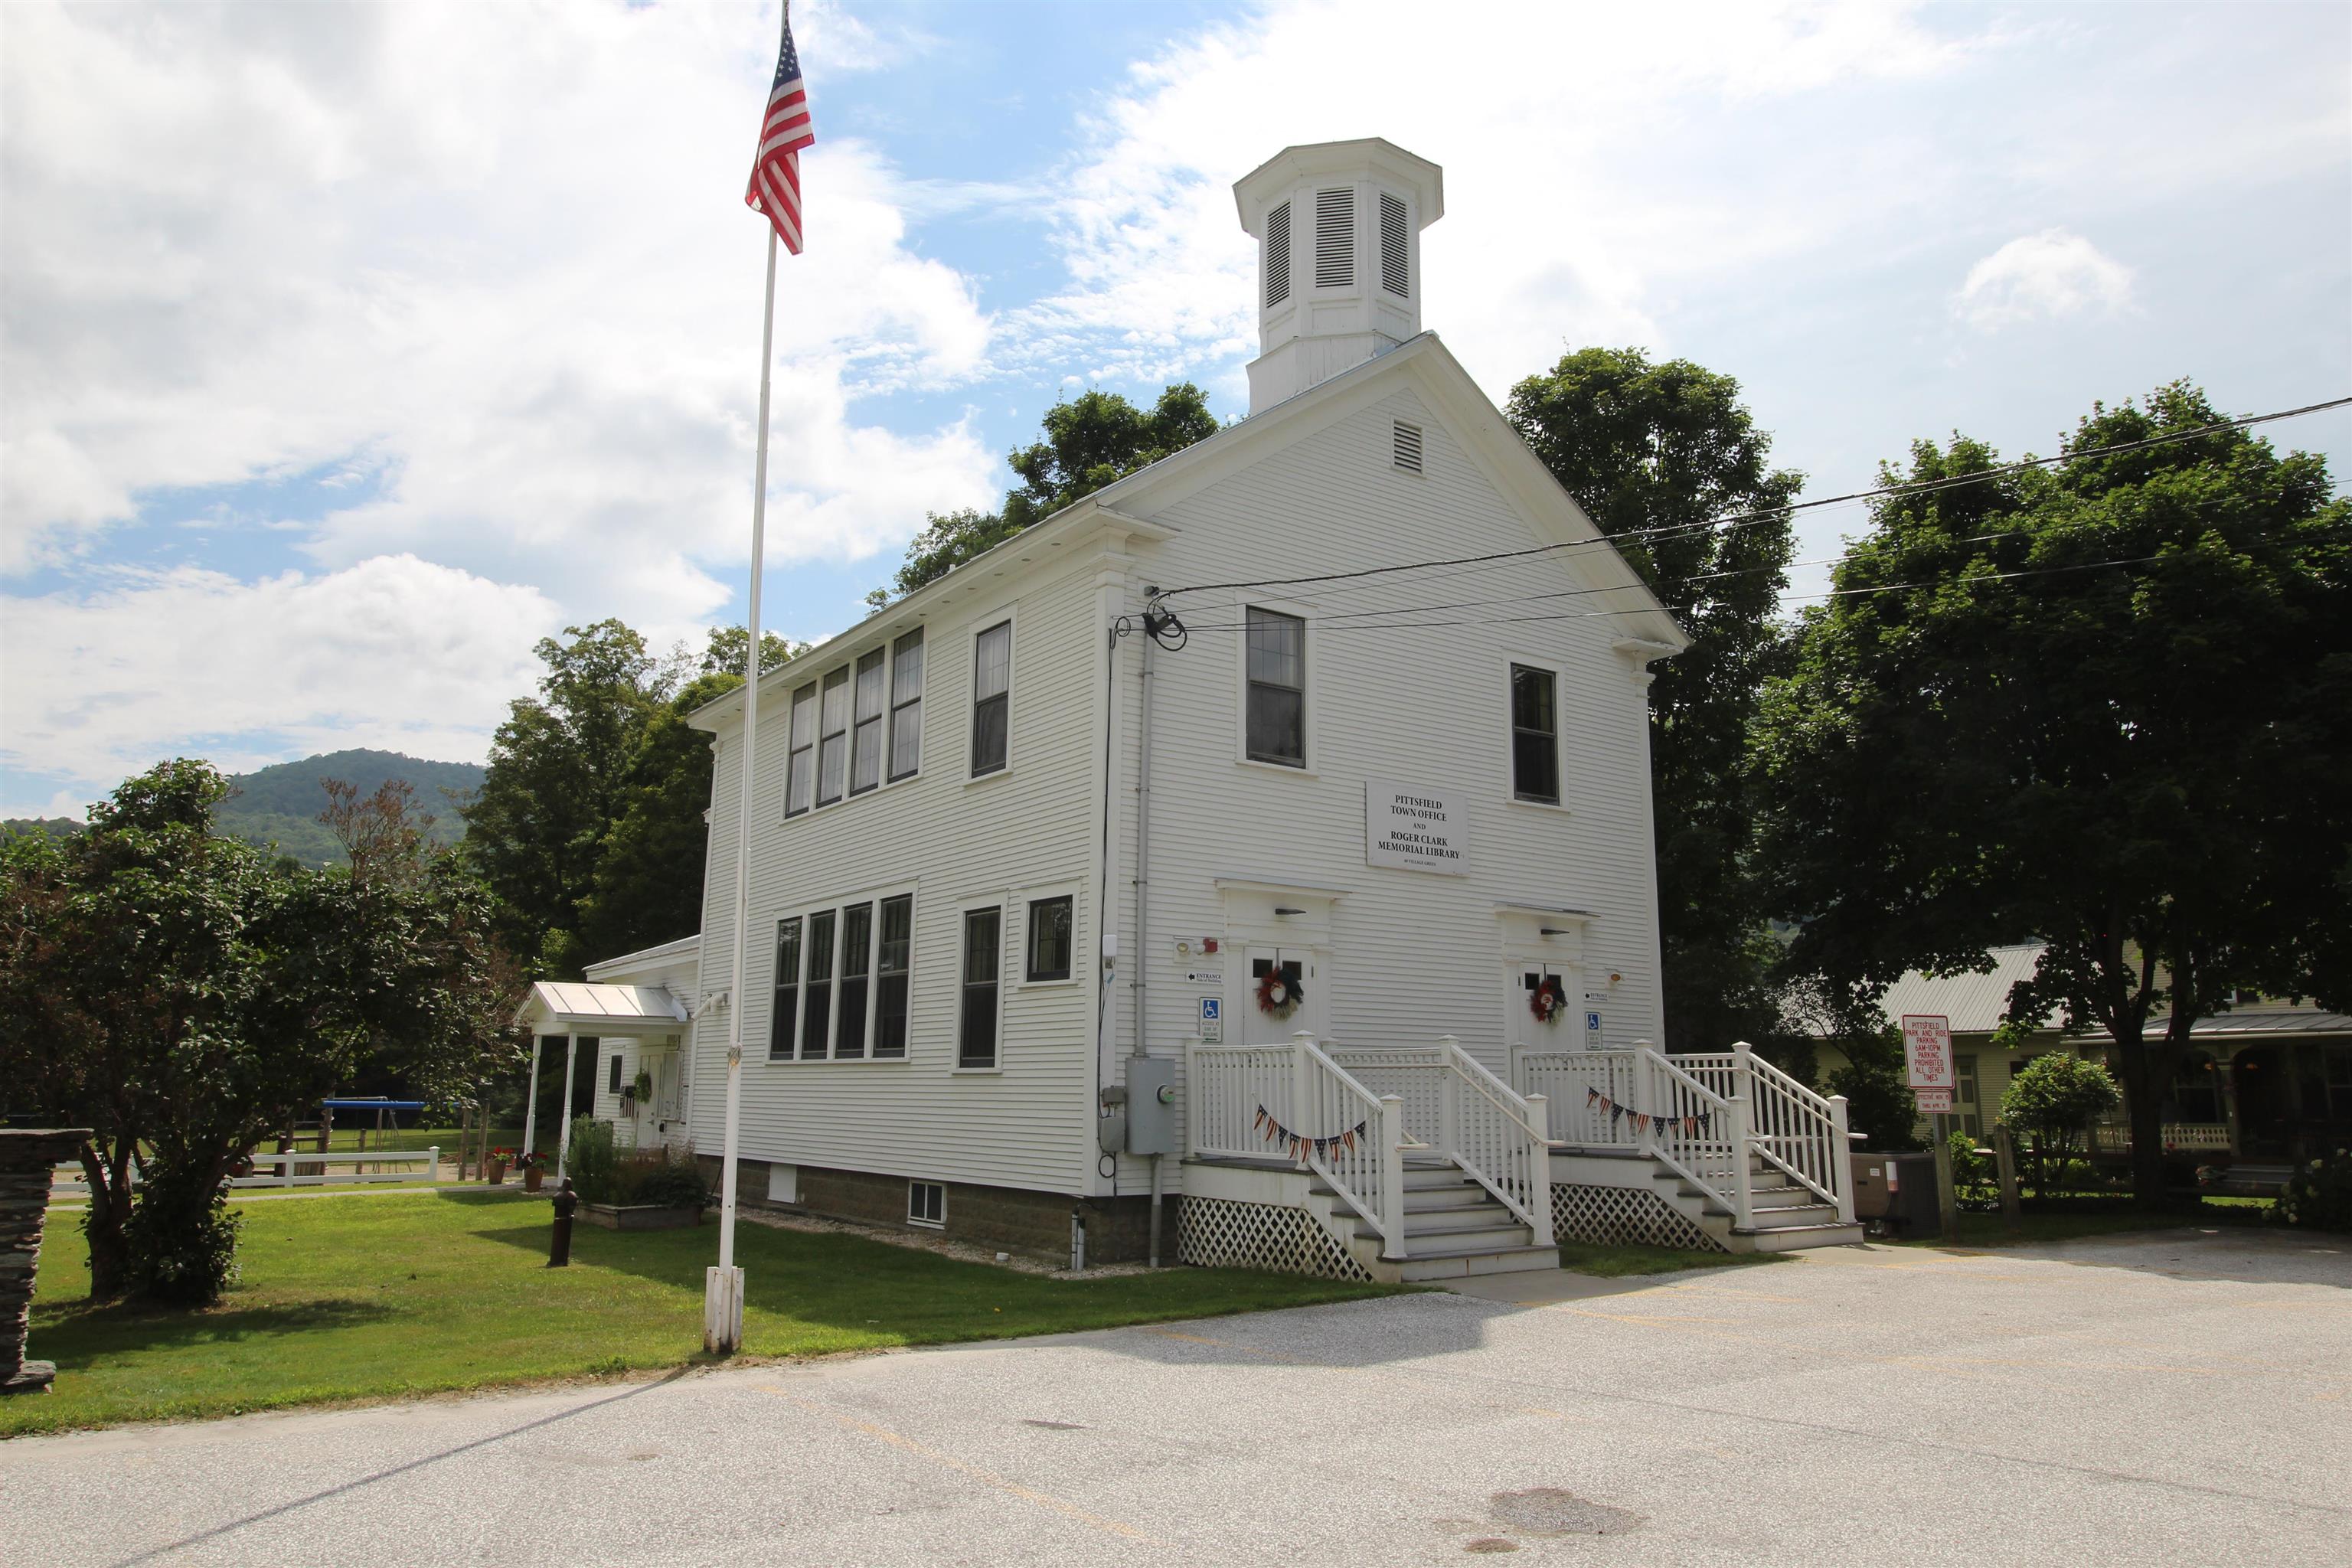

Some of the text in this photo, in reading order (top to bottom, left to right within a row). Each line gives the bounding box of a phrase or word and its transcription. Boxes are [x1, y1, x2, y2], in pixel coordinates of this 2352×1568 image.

[1395, 795, 1442, 809] PITTSFIELD
[1390, 805, 1447, 822] TOWN OFFICE
[1390, 831, 1448, 847] ROGER CLARK
[1378, 841, 1460, 859] MEMORIAL LIBRARY
